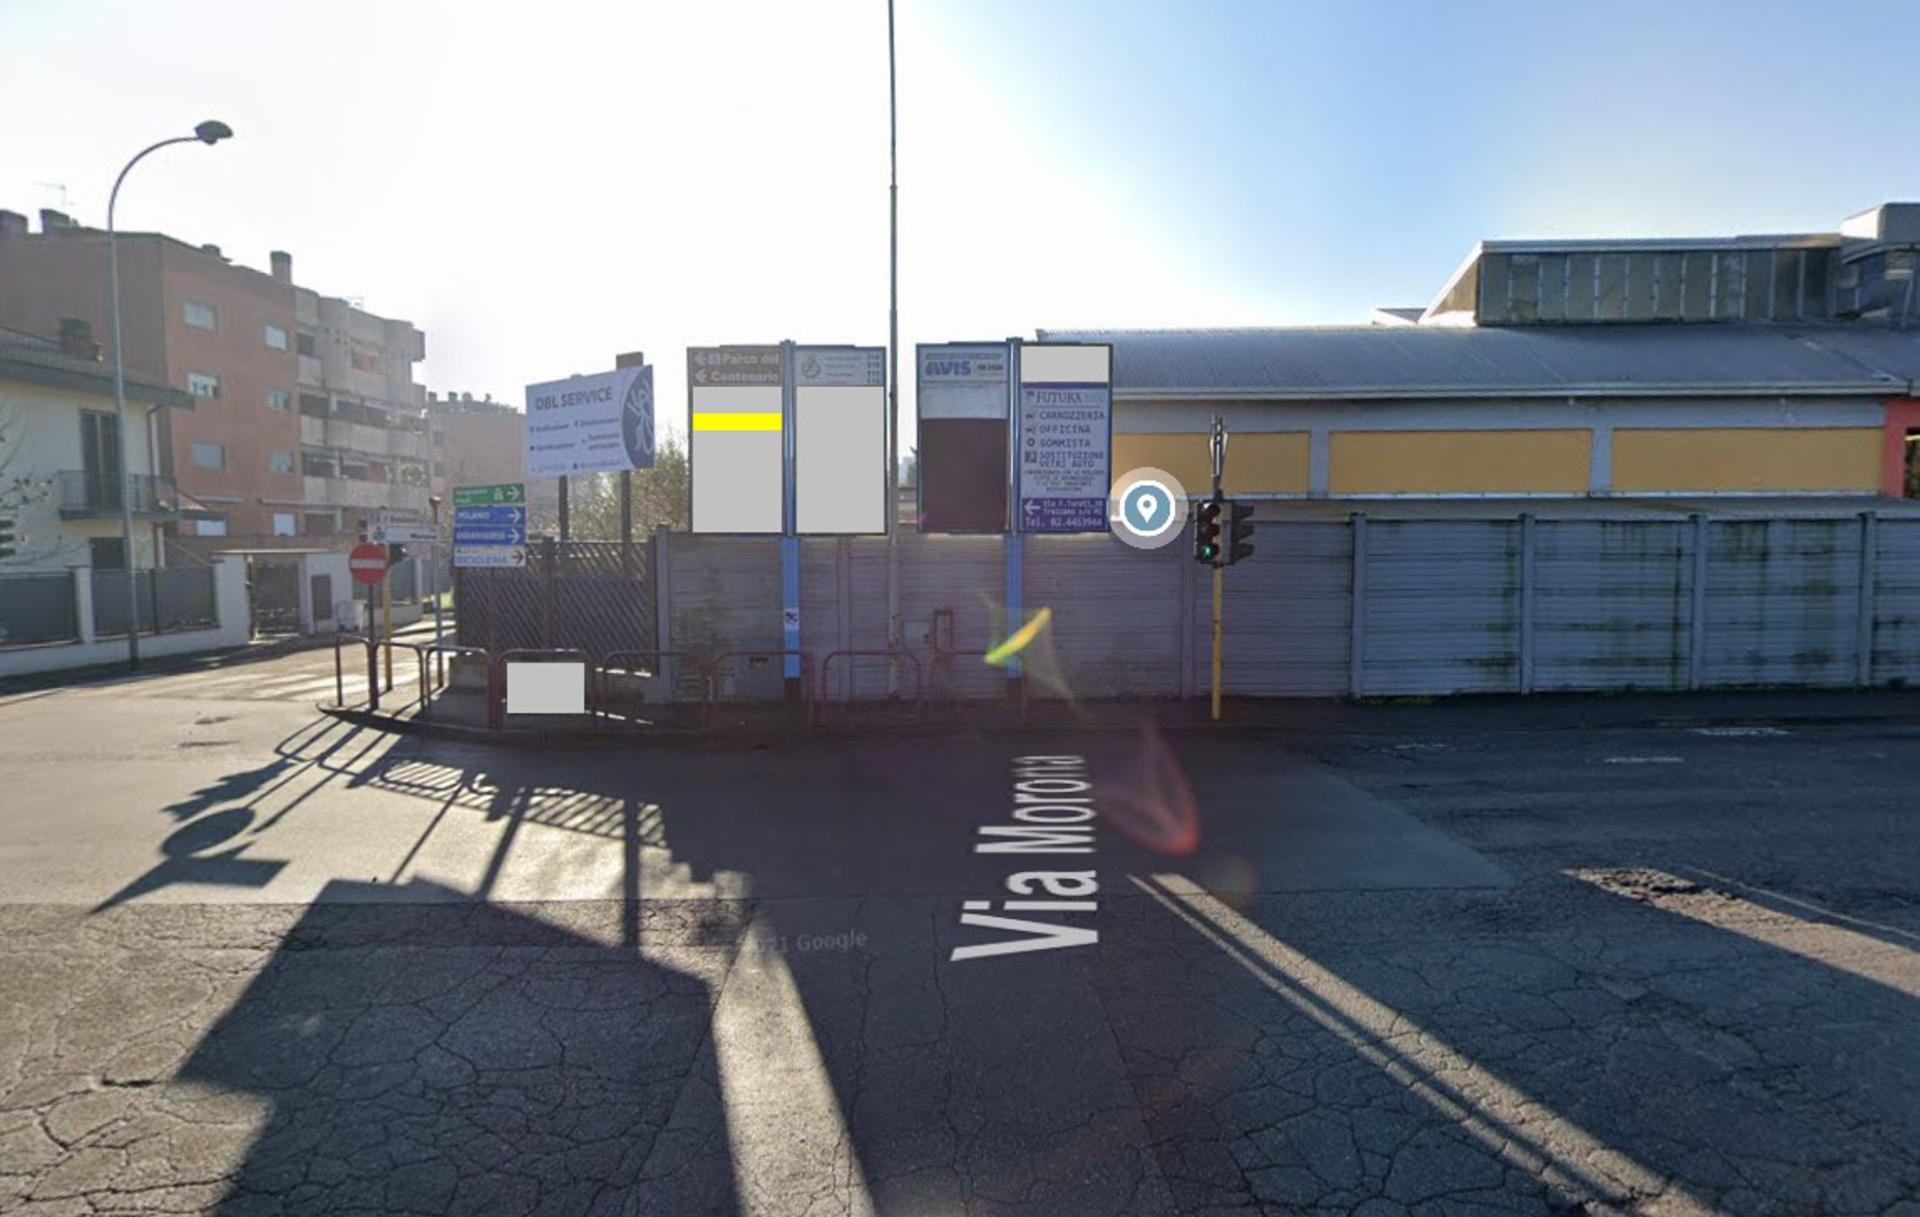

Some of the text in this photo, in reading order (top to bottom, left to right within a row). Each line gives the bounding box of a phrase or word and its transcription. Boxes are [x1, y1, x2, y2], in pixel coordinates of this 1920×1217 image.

[723, 352, 758, 365] Parco
[925, 361, 971, 376] AVIS
[711, 370, 779, 382] Centenario
[561, 386, 613, 408] SERVICE
[1040, 410, 1106, 420] CARROZZERIA
[1039, 424, 1092, 435] OFFICINA
[1040, 438, 1091, 448] GOMMISTA
